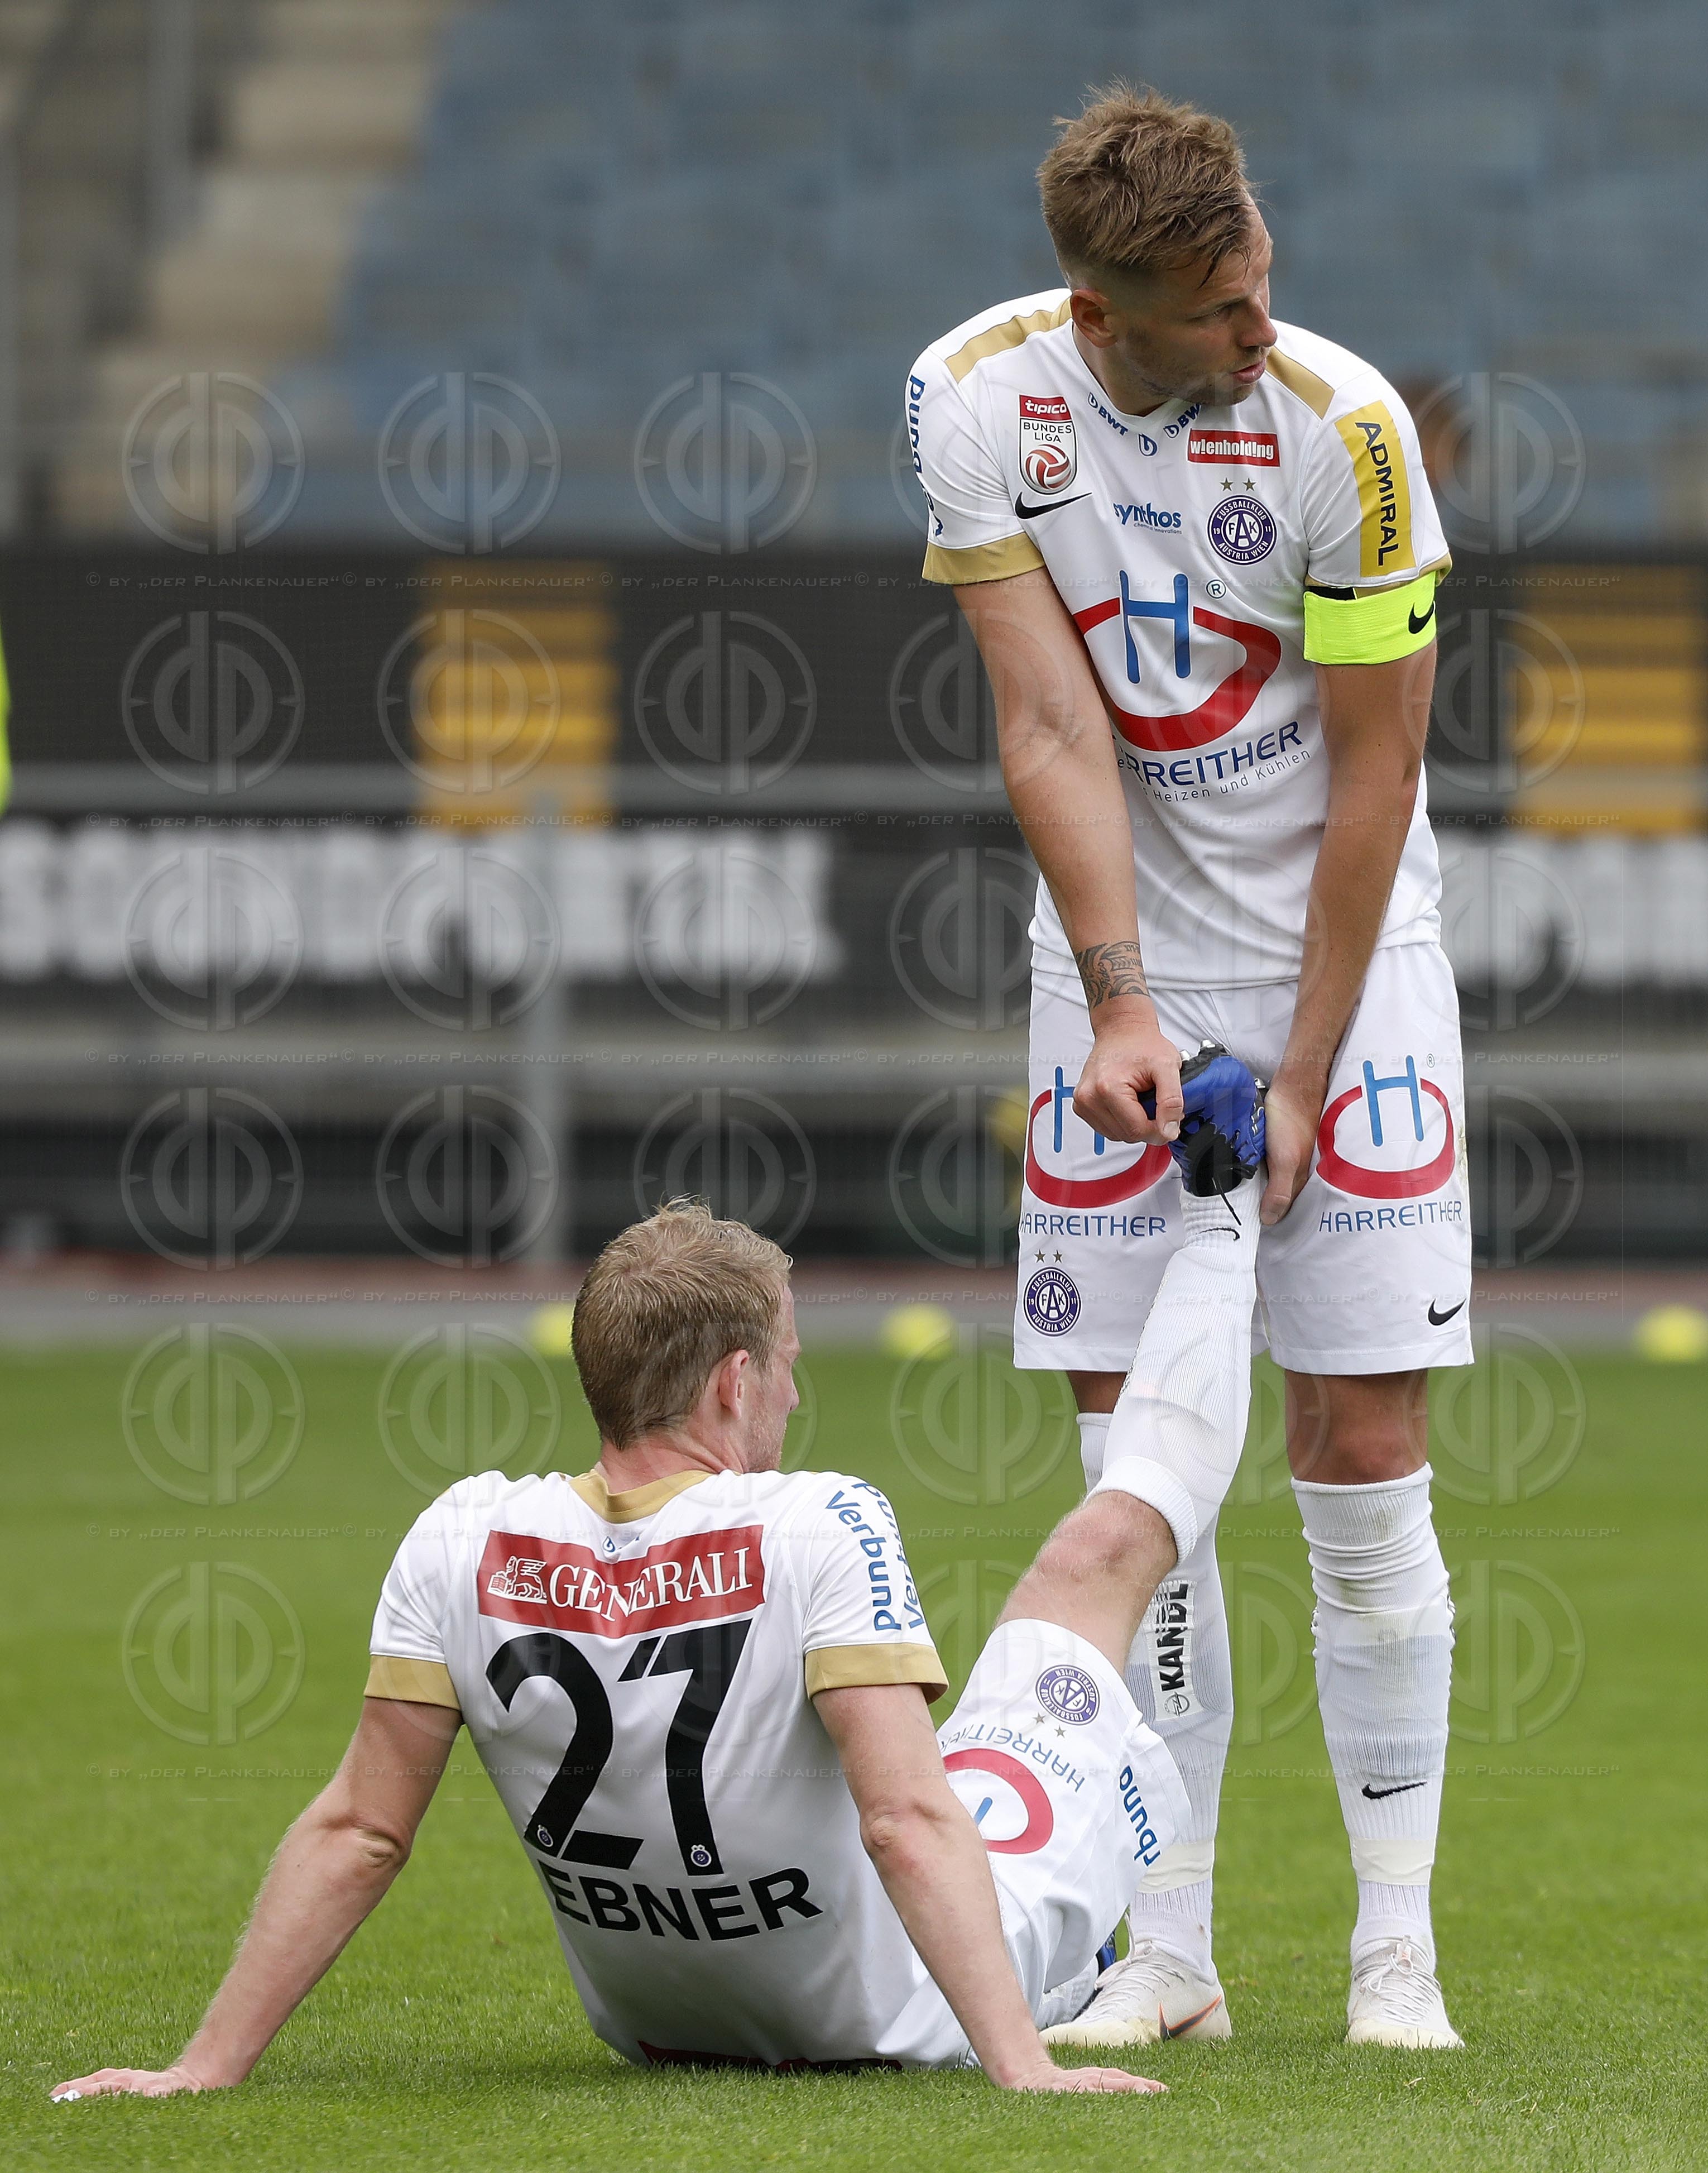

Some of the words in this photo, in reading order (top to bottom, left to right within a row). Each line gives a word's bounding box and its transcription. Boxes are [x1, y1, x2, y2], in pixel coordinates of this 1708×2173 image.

[1025, 399, 1067, 414] tipico
[1098, 405, 1129, 436] BWT
[1177, 403, 1202, 429] BW
[1023, 422, 1072, 434] BUNDES
[1034, 432, 1062, 443] LIGA
[1217, 500, 1266, 520] FUSSBALLKLUB
[1355, 422, 1399, 566] ADMIRAL
[1113, 502, 1182, 528] synthos
[1218, 542, 1249, 560] AUSTRIA
[1250, 540, 1269, 557] WIEN
[1122, 721, 1303, 788] RREITHER
[1154, 787, 1211, 802] Heizen
[1220, 774, 1249, 794] und
[1255, 749, 1311, 780] Kühlen
[1318, 1200, 1462, 1233] HARREITHER
[825, 1490, 902, 1631] Verbund
[549, 1547, 753, 1622] GENERALI
[485, 1617, 754, 1876] 27
[538, 1859, 823, 1941] EBNER
